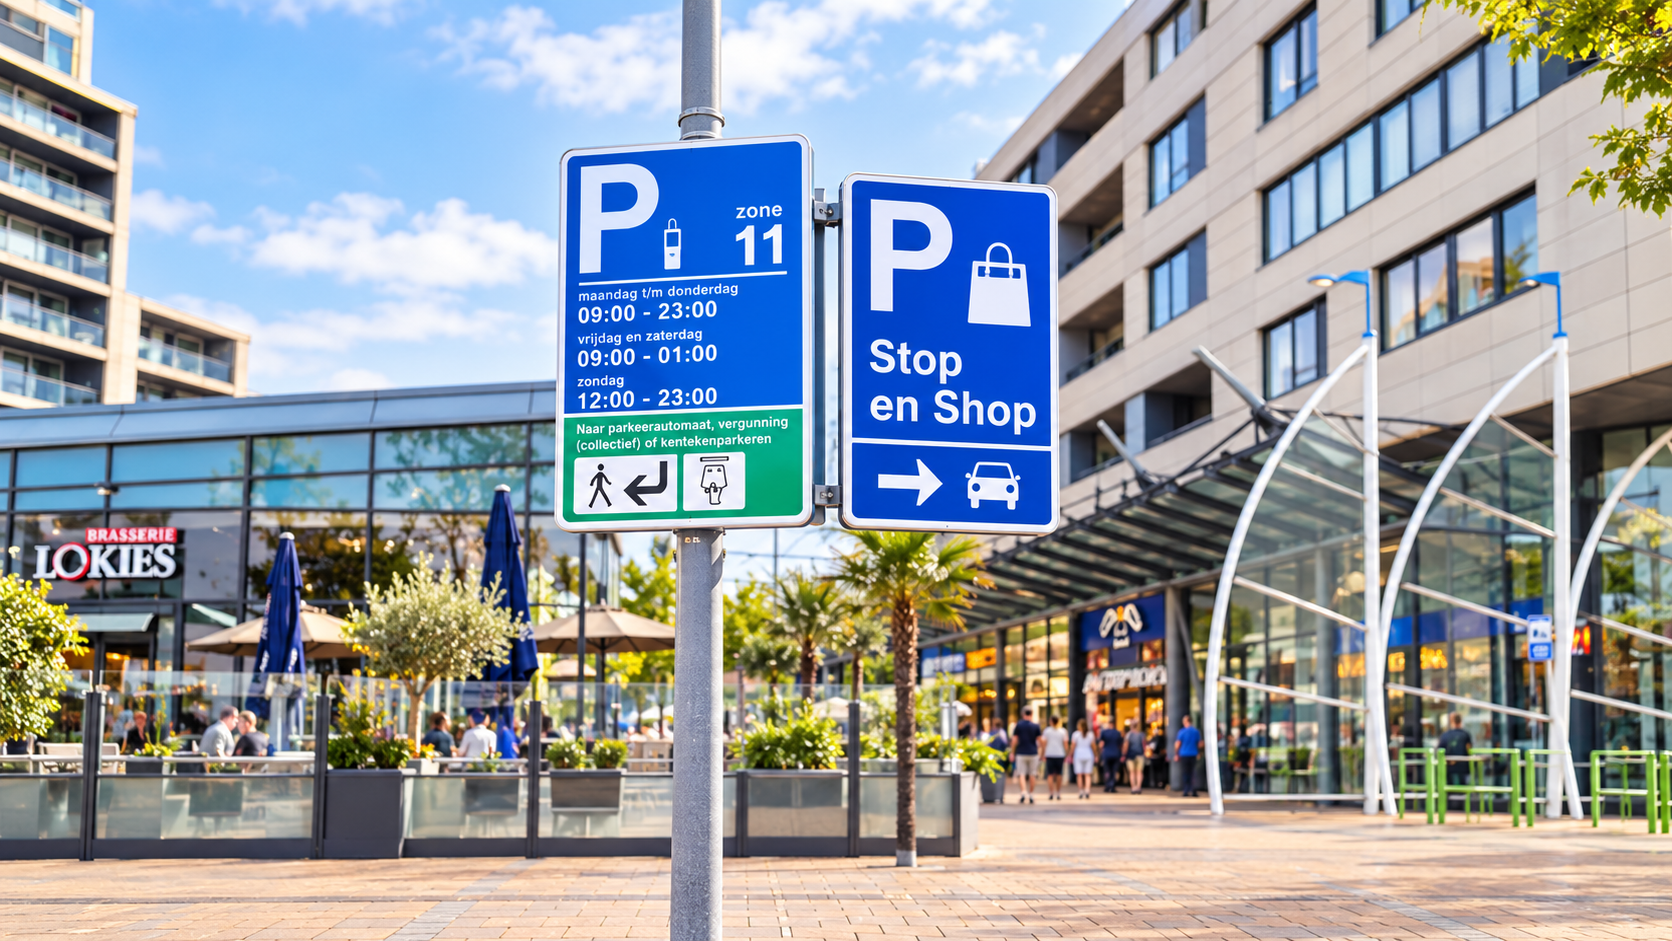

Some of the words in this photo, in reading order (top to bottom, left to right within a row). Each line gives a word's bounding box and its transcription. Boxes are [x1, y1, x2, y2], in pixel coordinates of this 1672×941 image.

[579, 163, 660, 274] P
[735, 204, 783, 219] zone
[735, 223, 783, 266] 11
[870, 198, 953, 312] P
[578, 288, 638, 302] maandag
[641, 286, 663, 299] t/m
[667, 283, 739, 297] donderdag
[578, 304, 636, 324] 09:00
[658, 300, 718, 320] 23:00
[577, 332, 622, 347] vrijdag
[625, 333, 642, 343] en
[645, 328, 703, 342] zaterdag
[577, 347, 636, 368] 09:00
[658, 344, 718, 364] 01:00
[869, 338, 963, 385] Stop
[577, 374, 625, 389] zondag
[577, 390, 635, 410] 12:00
[658, 386, 718, 407] 23:00
[870, 395, 919, 422] en
[933, 389, 1037, 436] Shop
[576, 423, 606, 435] Naar
[608, 418, 715, 436] parkeerautomaat,
[717, 416, 789, 431] vergunning
[576, 436, 641, 453] (collectief)
[644, 435, 658, 449] of
[660, 433, 772, 449] kentekenparkeren
[87, 527, 176, 542] BRASSERIE
[32, 542, 177, 582] LOKIES
